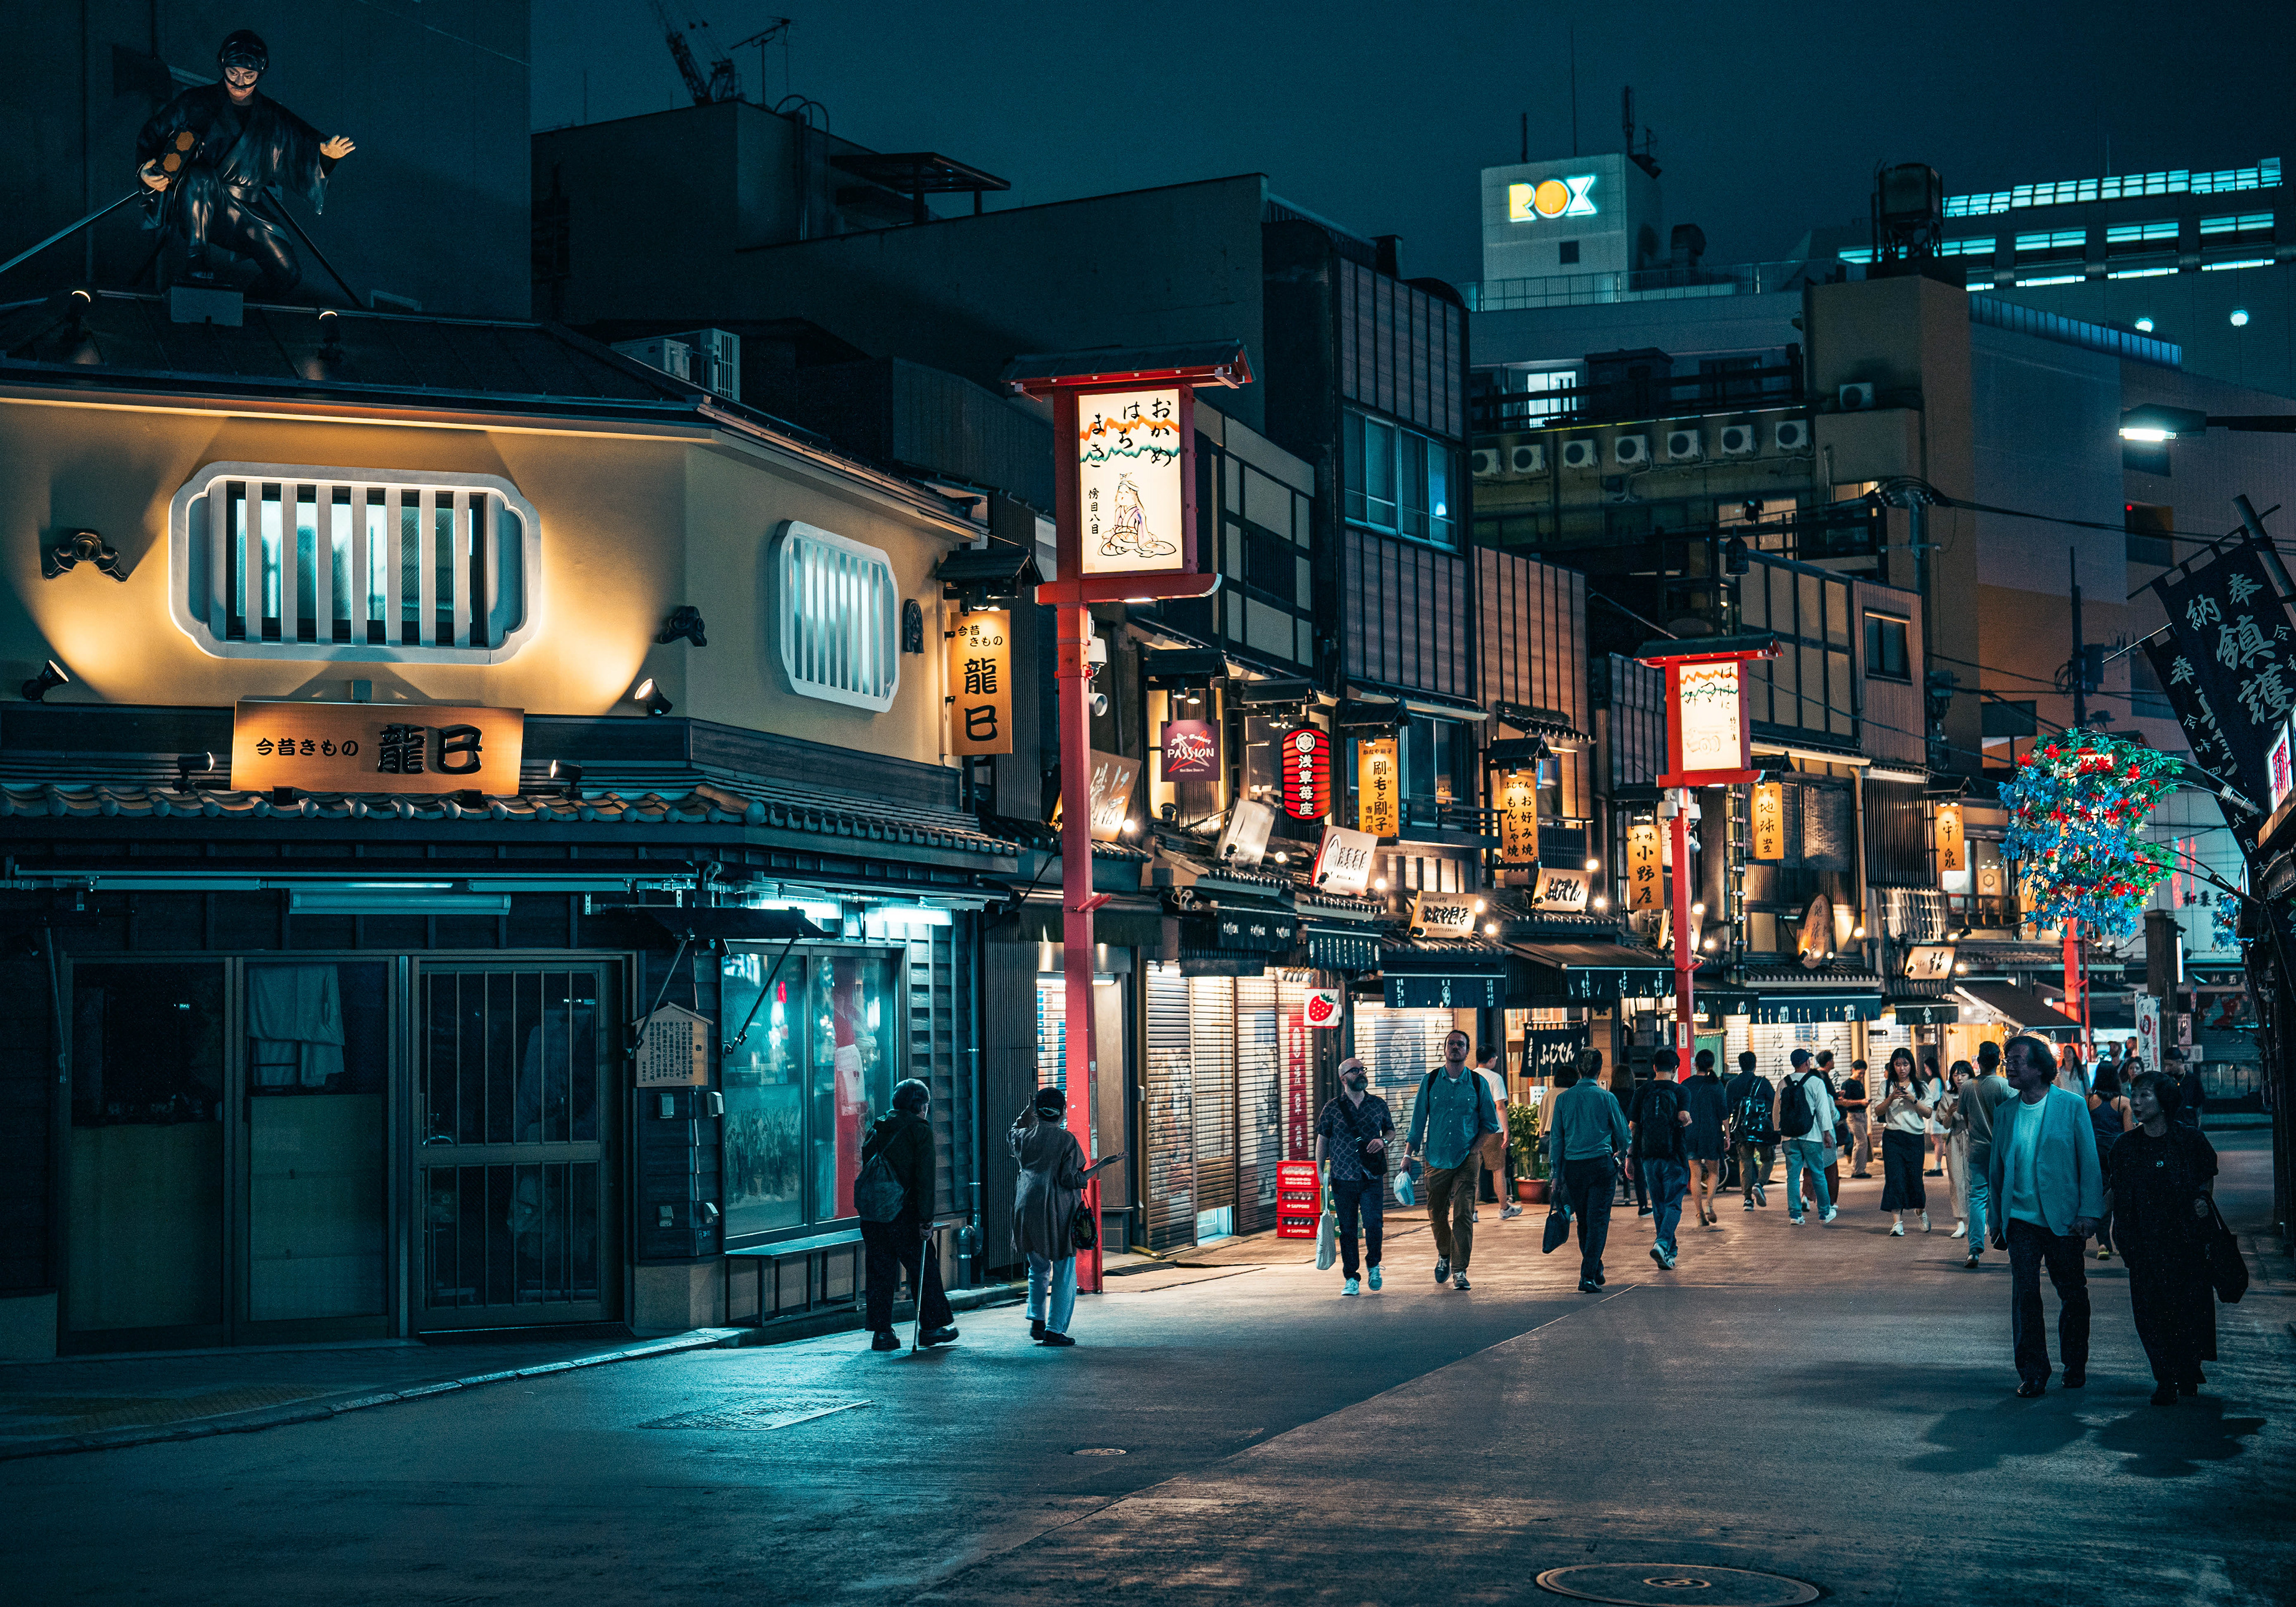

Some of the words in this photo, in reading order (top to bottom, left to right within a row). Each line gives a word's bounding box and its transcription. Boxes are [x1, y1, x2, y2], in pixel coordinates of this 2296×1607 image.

[1508, 175, 1597, 222] ROX
[1151, 398, 1172, 468] おかめ
[958, 625, 980, 637] 今昔
[969, 636, 1003, 647] きもの
[2216, 615, 2294, 731] 鎮護
[256, 737, 359, 757] 今昔きもの
[1167, 747, 1214, 760] PASSION
[1298, 754, 1314, 815] 浅草苺座
[1373, 760, 1387, 831] 刷毛と刷子
[1521, 796, 1534, 856] お好み焼
[1943, 821, 1956, 868] 平泉
[1636, 845, 1655, 904] 小野屋
[1540, 1042, 1576, 1065] ふじでん
